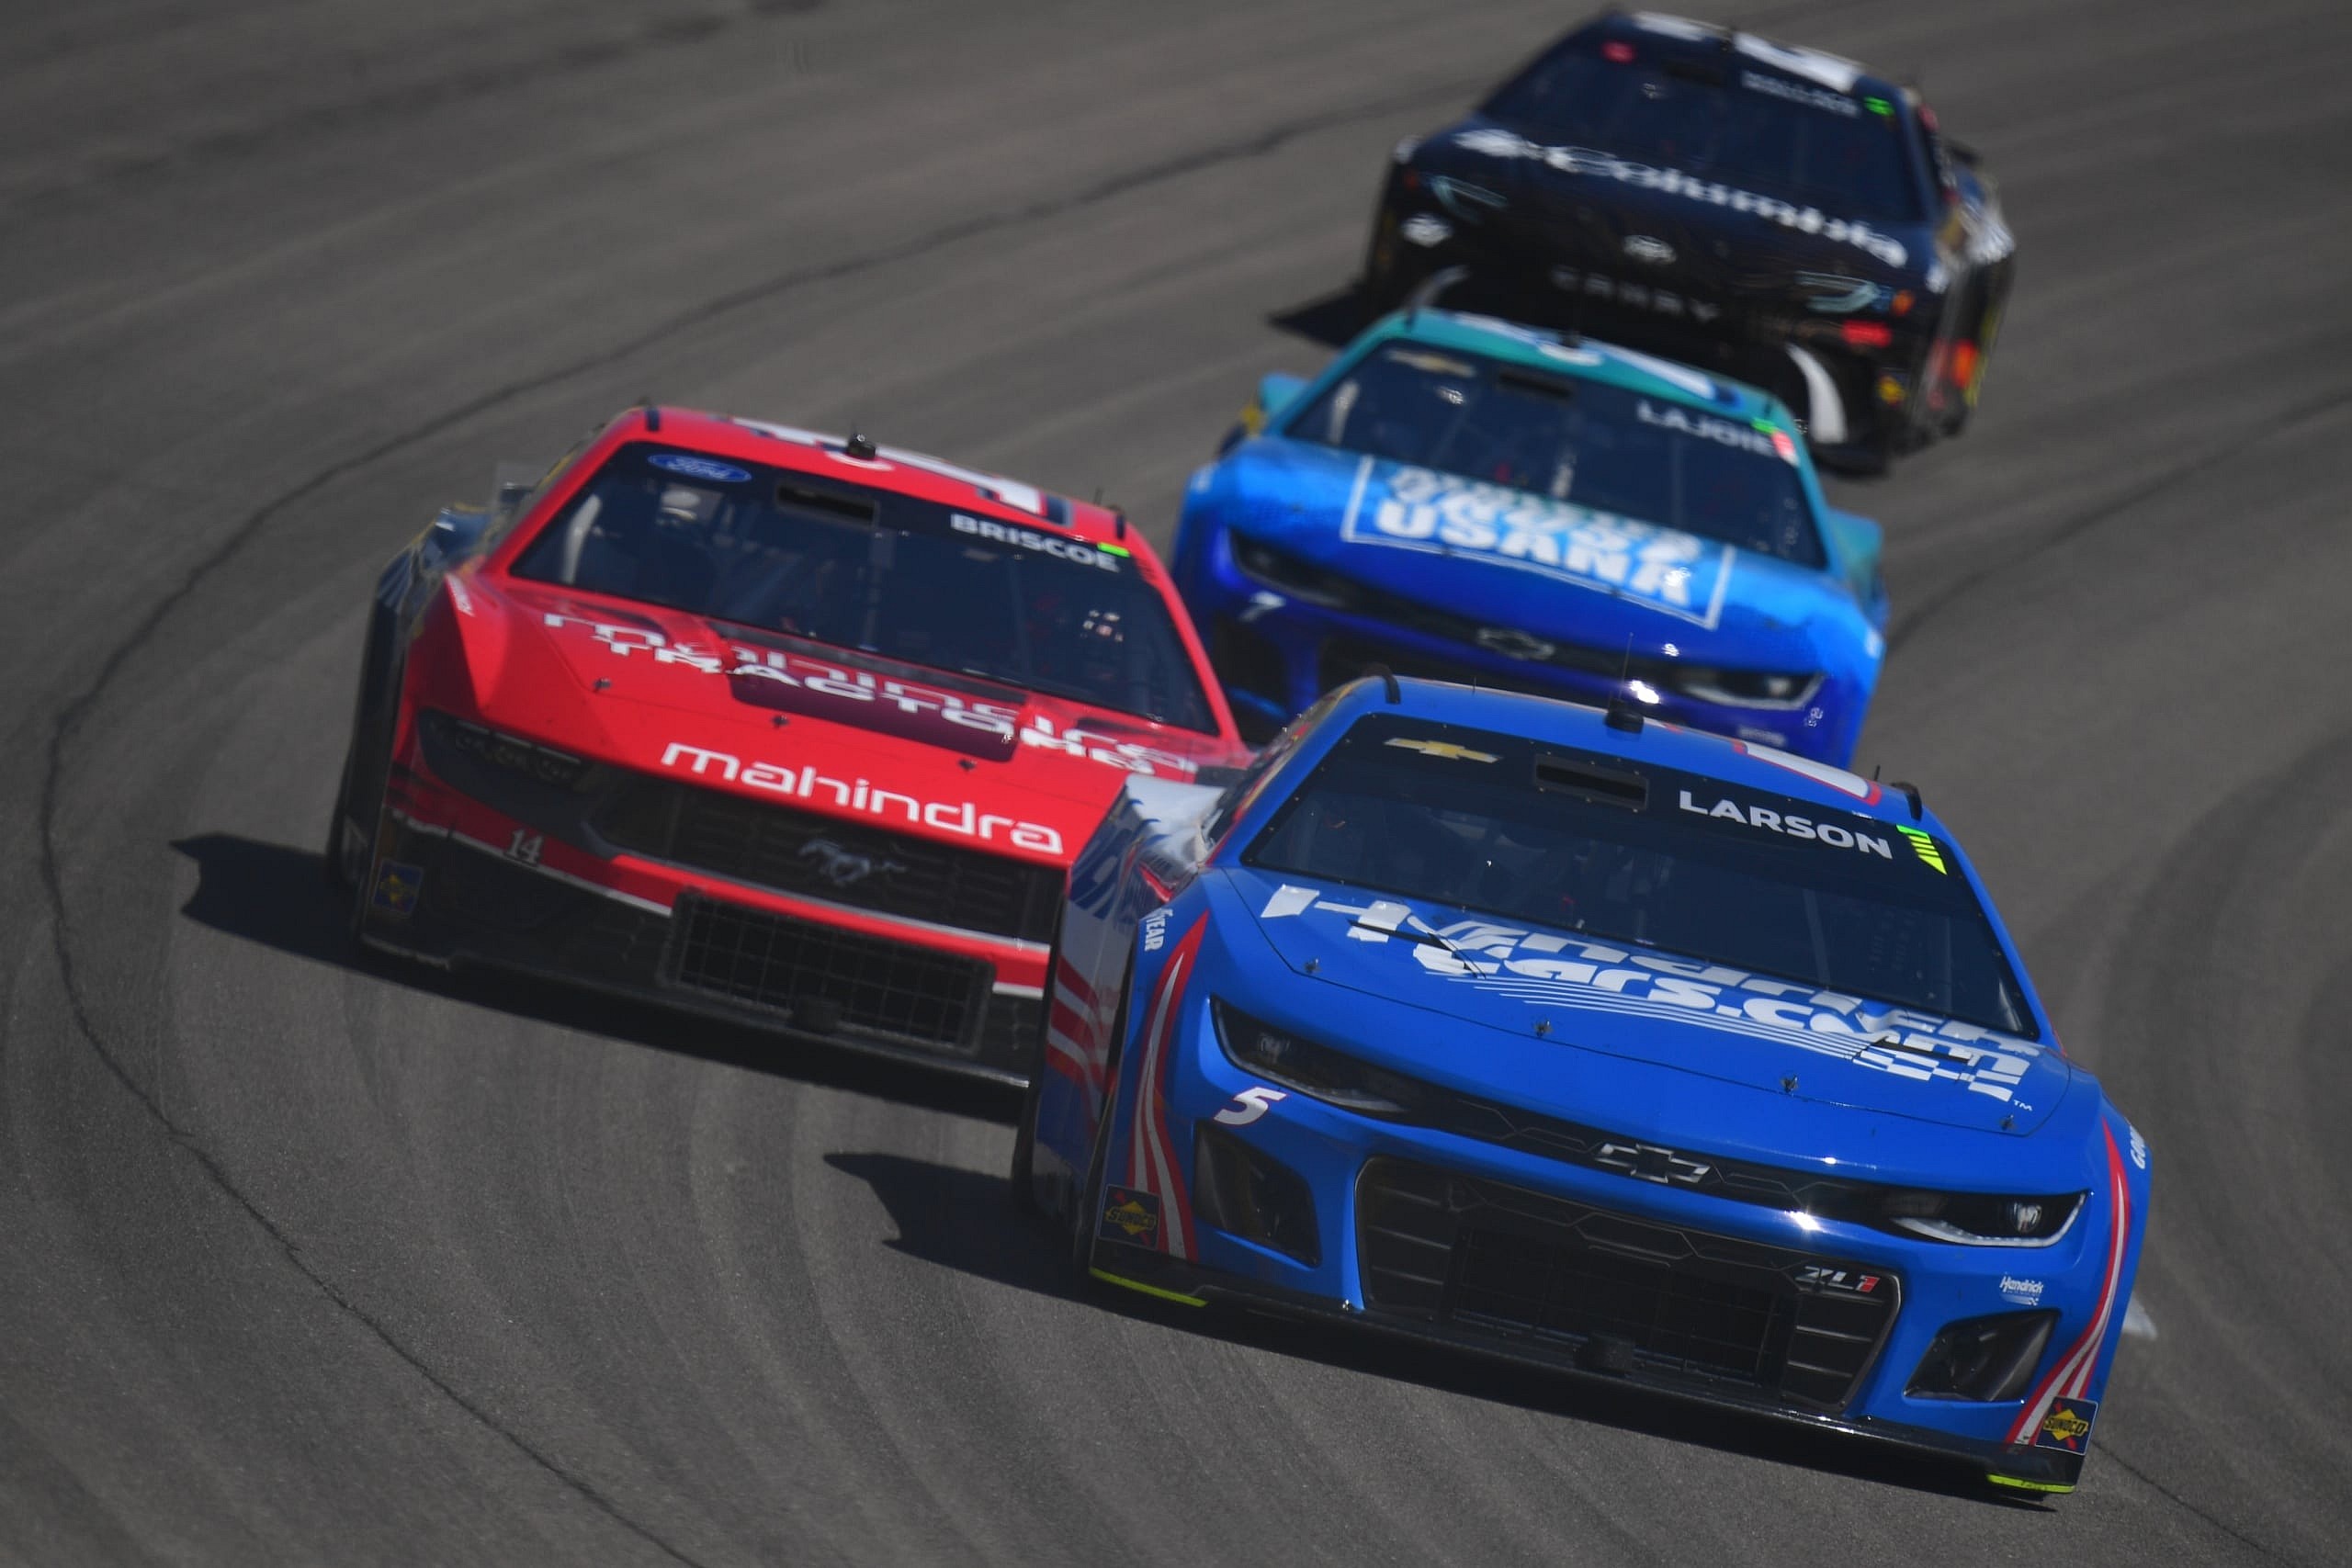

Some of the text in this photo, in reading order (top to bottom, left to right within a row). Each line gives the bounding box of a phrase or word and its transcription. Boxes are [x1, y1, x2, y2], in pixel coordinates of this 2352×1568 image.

[1637, 399, 1780, 457] LAJOIE
[950, 513, 1121, 573] BRISCOE
[1374, 493, 1691, 607] USANA
[661, 742, 1064, 854] mahindra
[508, 829, 543, 863] 14
[1679, 790, 1894, 860] LARSON
[1213, 1087, 1287, 1126] 5
[1795, 1266, 1881, 1293] ZL1
[1999, 1276, 2043, 1293] Hendrick
[2044, 1416, 2088, 1437] SUNOCO
